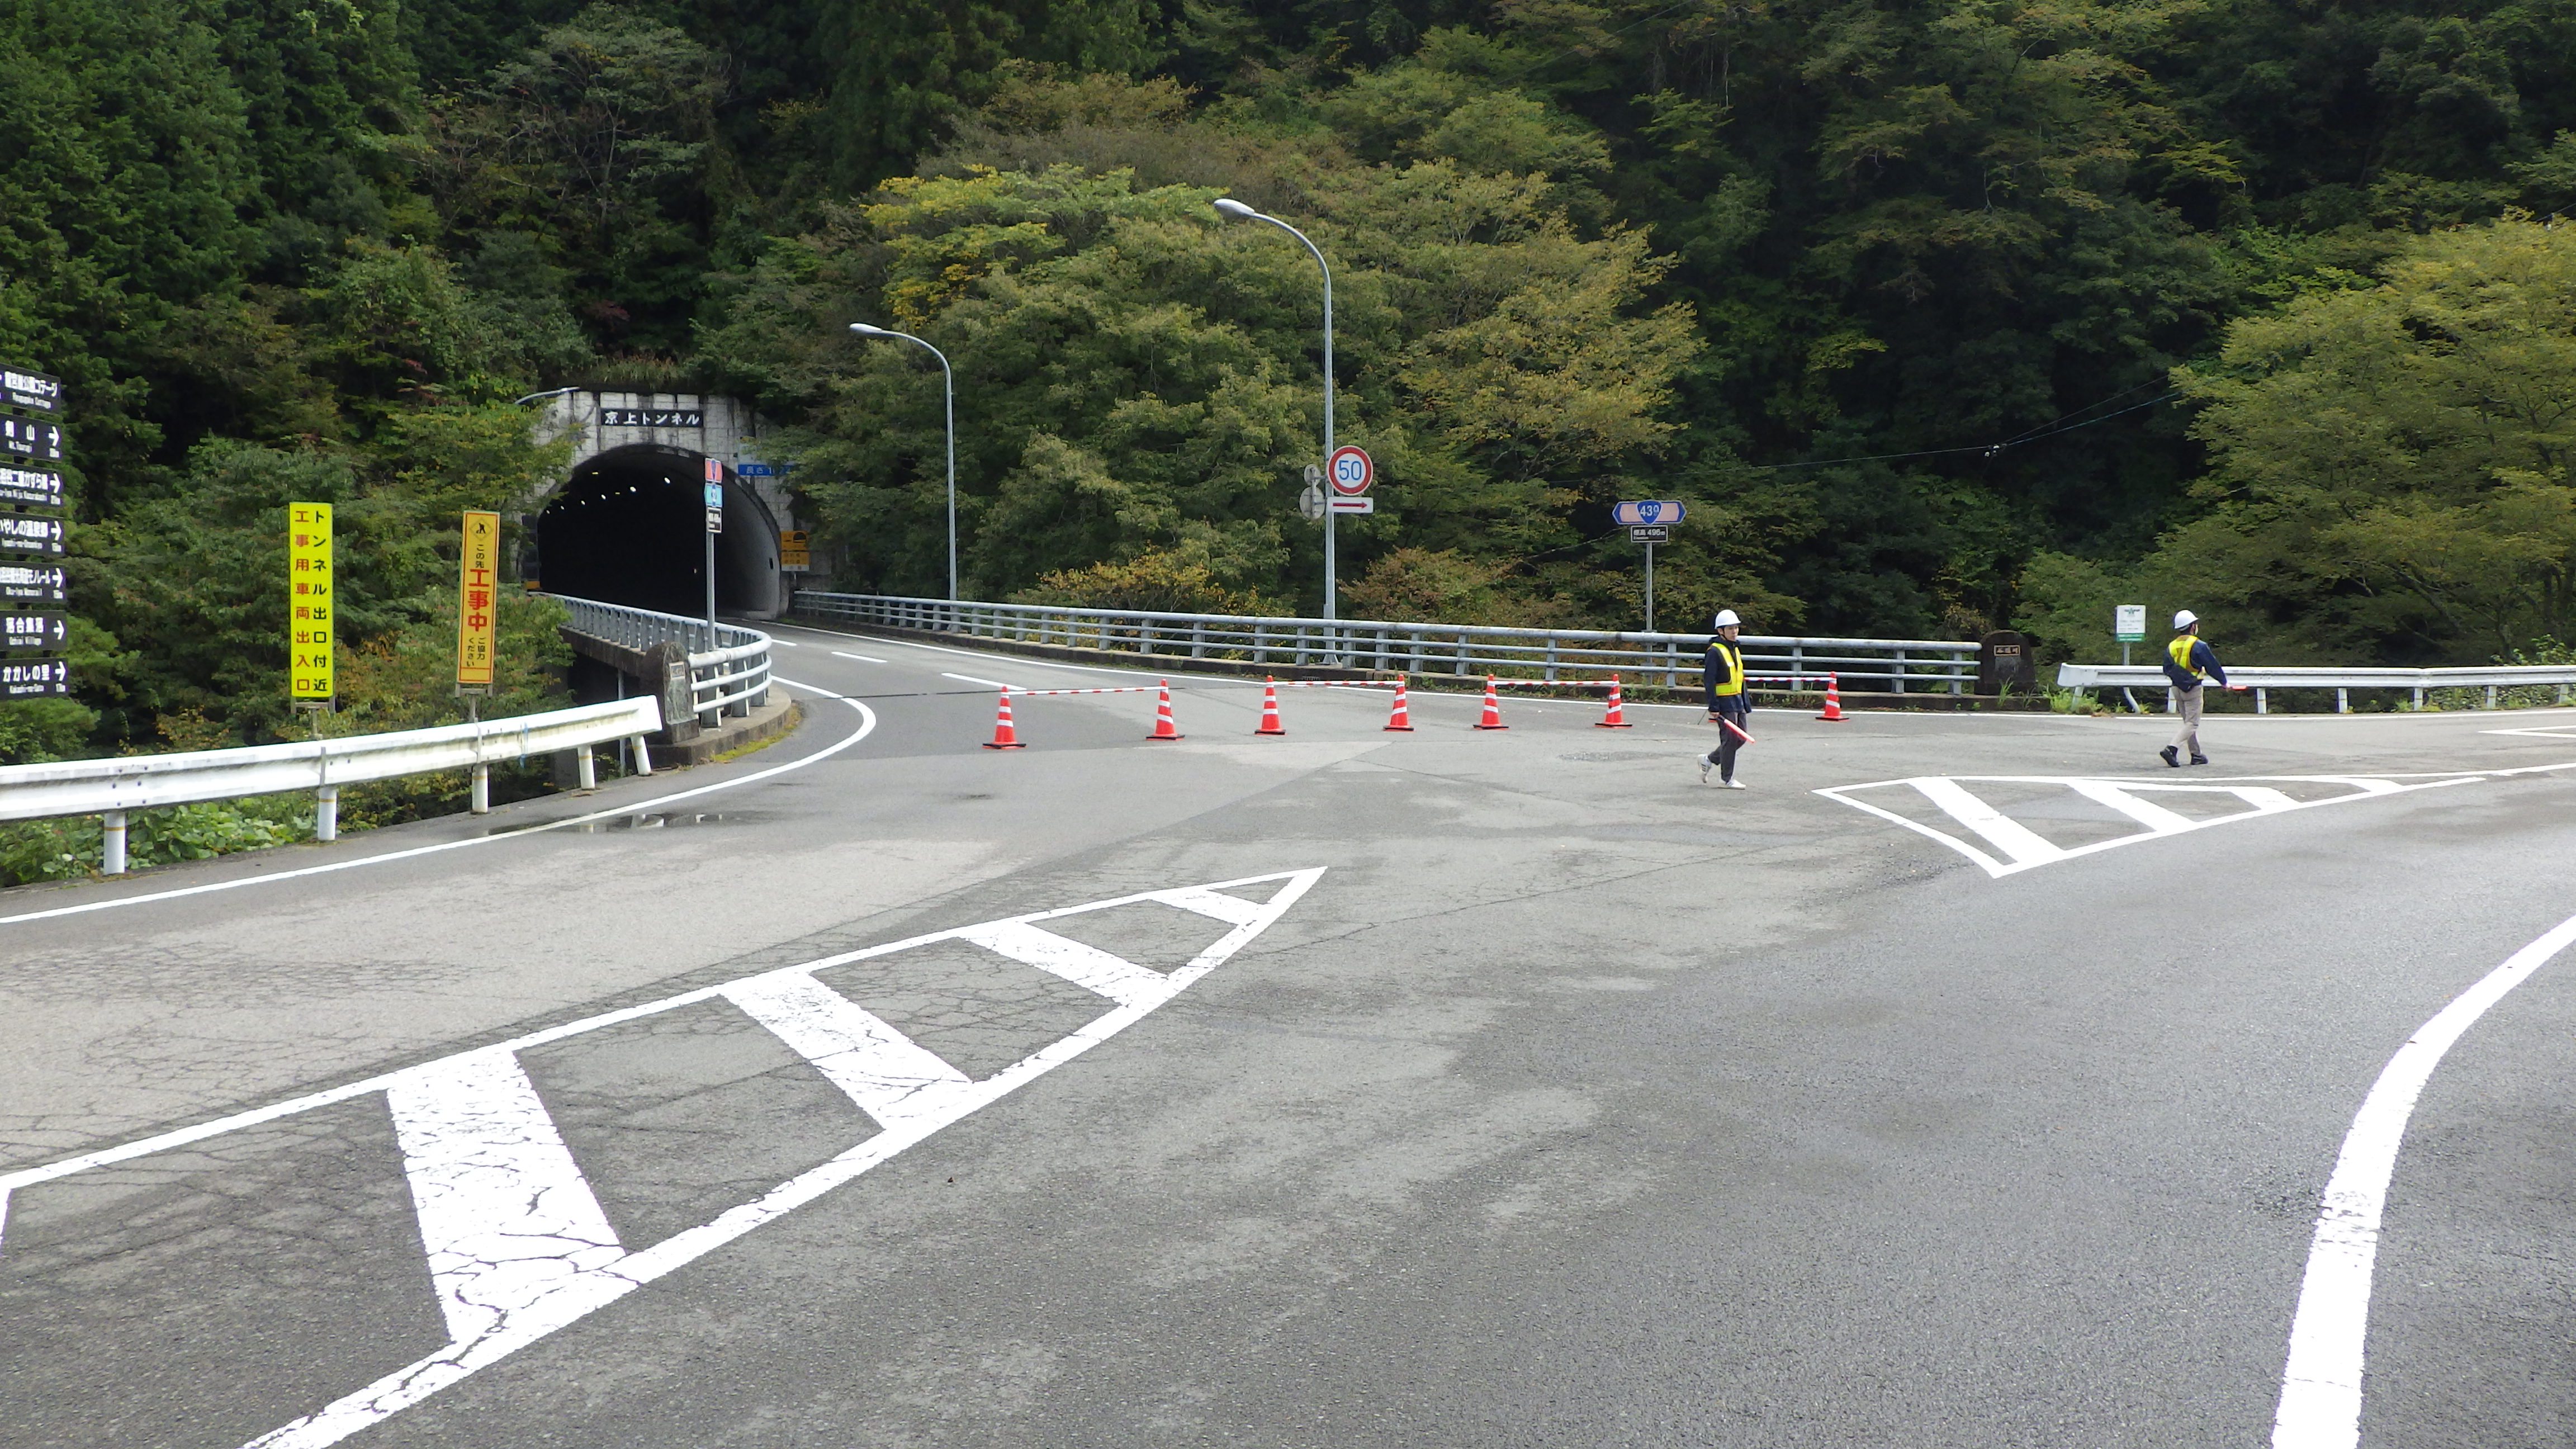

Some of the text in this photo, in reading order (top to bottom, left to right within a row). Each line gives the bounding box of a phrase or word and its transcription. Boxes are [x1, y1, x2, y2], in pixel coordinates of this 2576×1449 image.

[605, 411, 699, 425] 京上トンネル
[1339, 460, 1362, 480] 50
[475, 544, 485, 569] この先
[295, 510, 310, 691] 工事用車両出入口
[313, 510, 328, 692] トンネル出口付近
[467, 569, 490, 632] 工事中
[477, 637, 486, 660] ご協力
[3, 664, 50, 682] かかしの里
